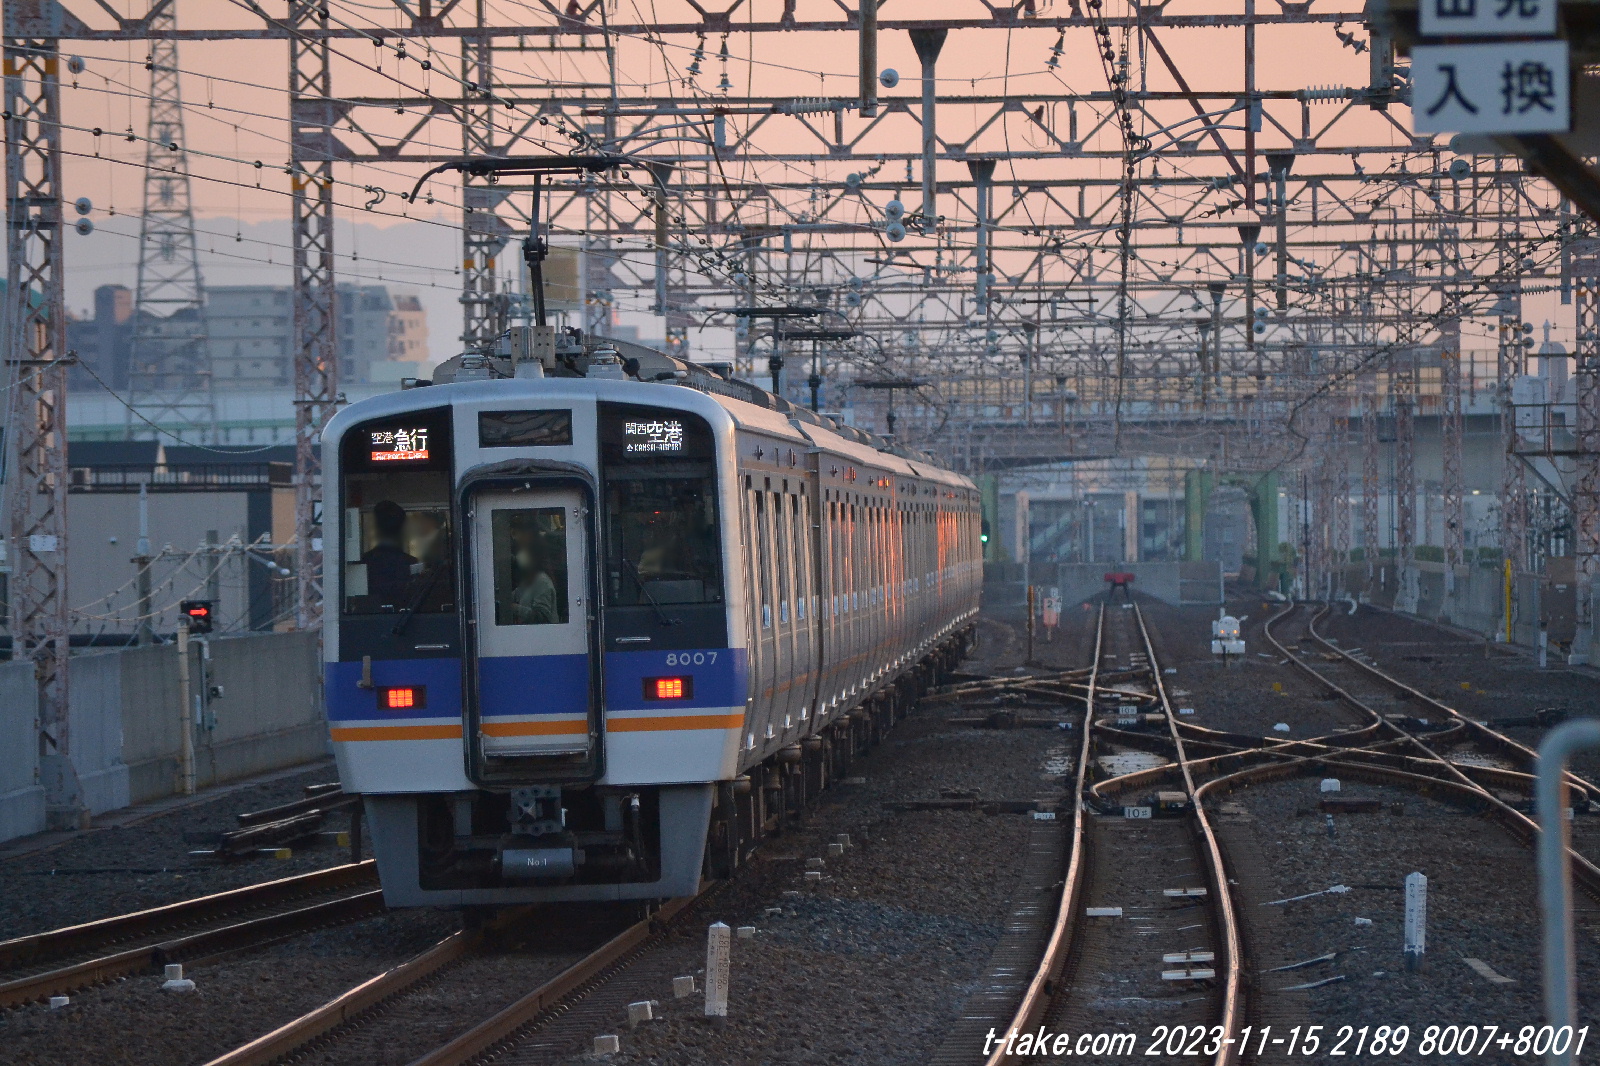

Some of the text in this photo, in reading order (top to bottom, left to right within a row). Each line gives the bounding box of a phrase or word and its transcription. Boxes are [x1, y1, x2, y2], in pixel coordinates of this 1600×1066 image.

[1426, 61, 1555, 116] 入換
[371, 428, 428, 452] 空港急行
[625, 421, 683, 444] 関西空港
[666, 651, 718, 667] 8007
